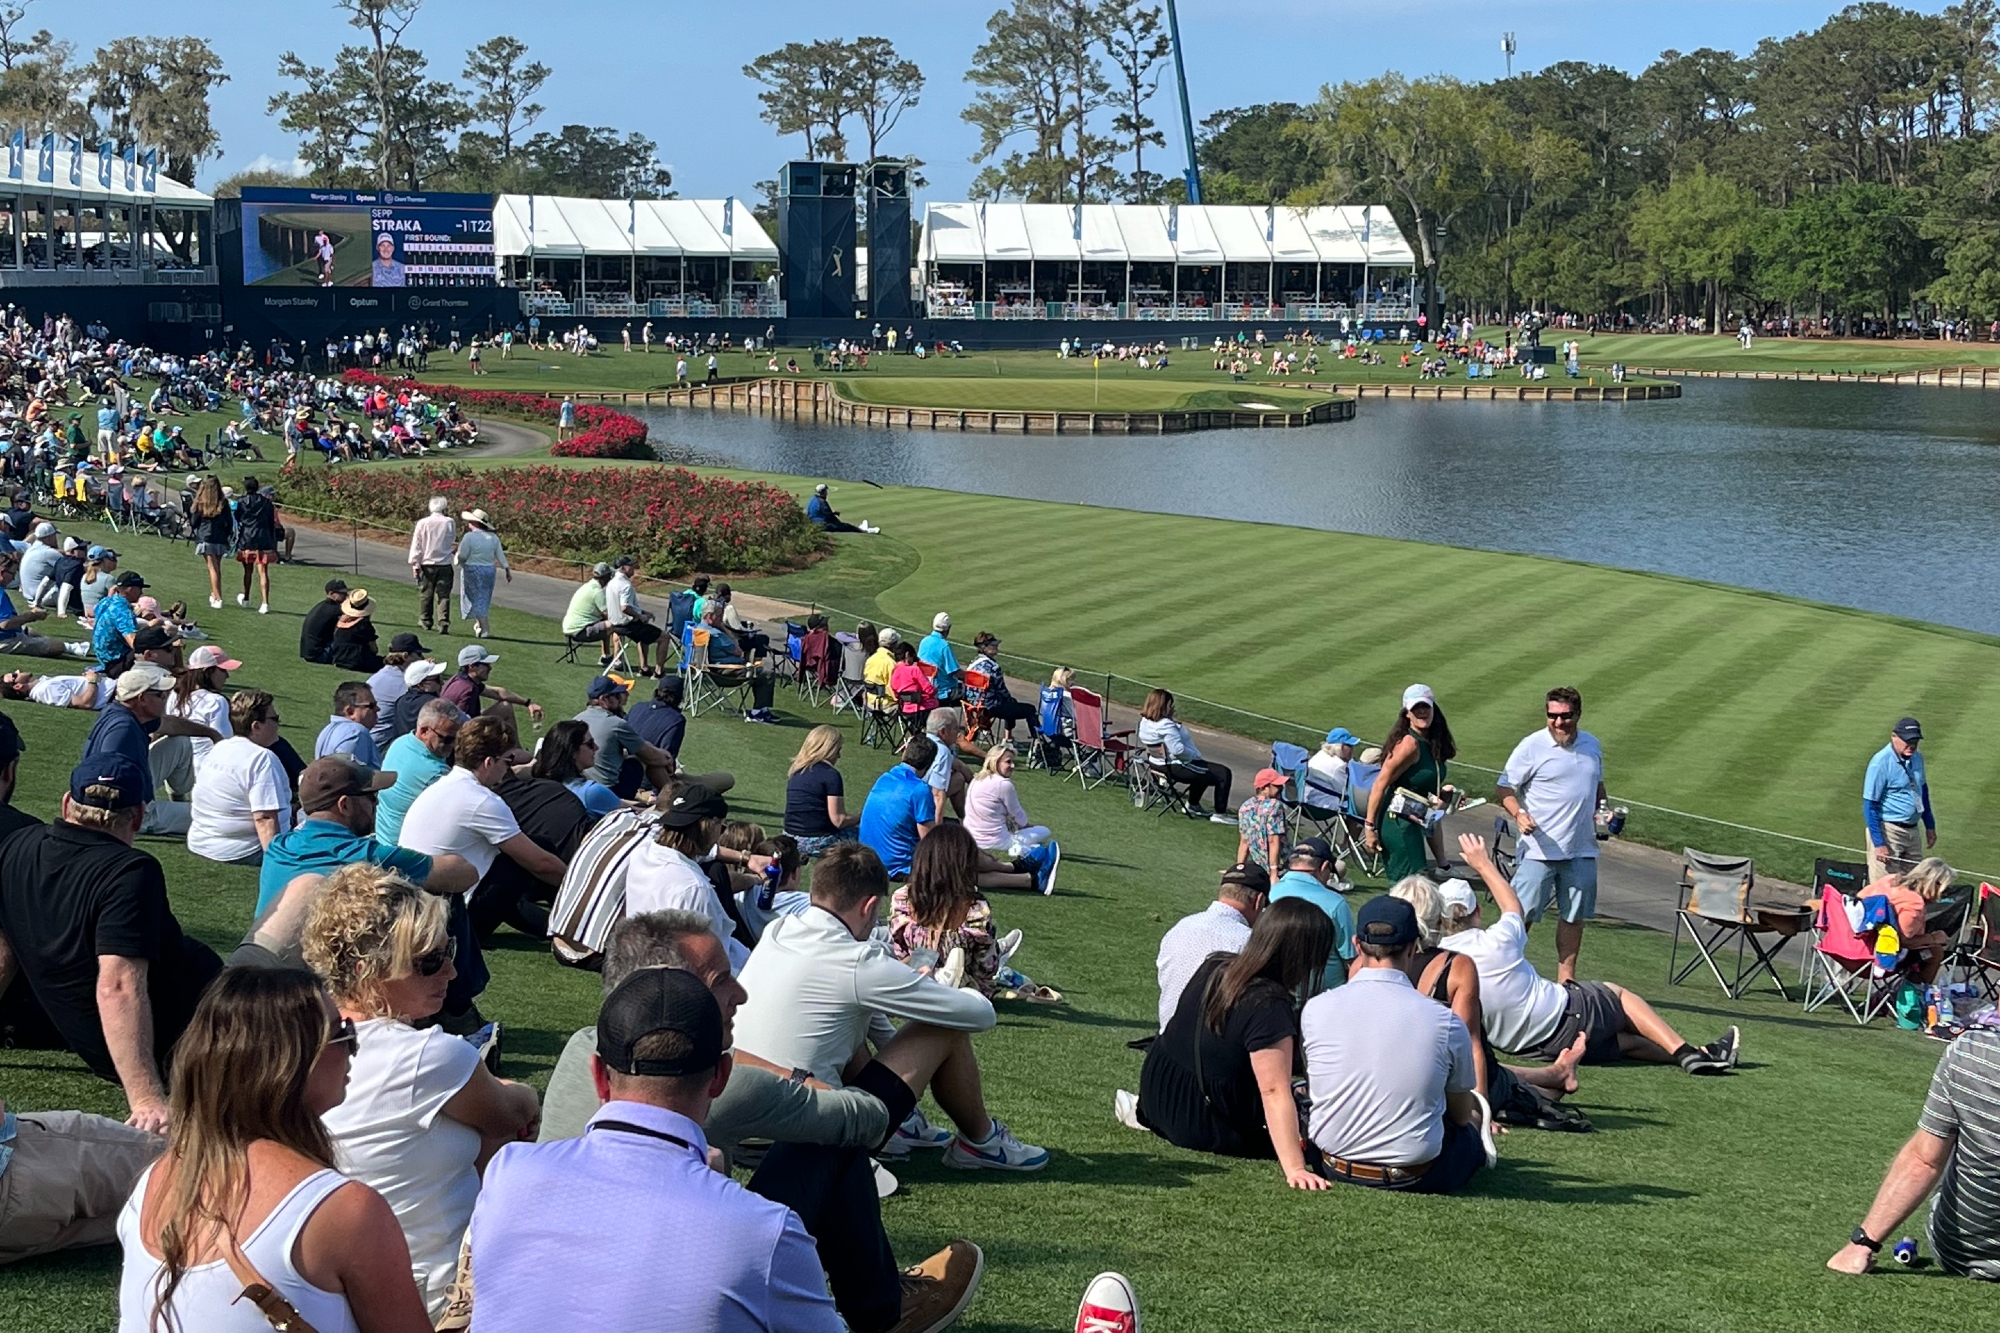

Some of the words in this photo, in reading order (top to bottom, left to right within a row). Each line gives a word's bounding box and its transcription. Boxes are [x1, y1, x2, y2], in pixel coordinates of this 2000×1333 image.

[371, 209, 393, 218] SEPP
[372, 219, 422, 232] STRAKA
[470, 220, 492, 233] T22
[405, 234, 424, 242] FIRST
[264, 297, 292, 308] Morgan
[292, 298, 319, 308] Stanley
[349, 298, 378, 308] Optum
[422, 298, 440, 307] Grant
[205, 329, 214, 339] 17
